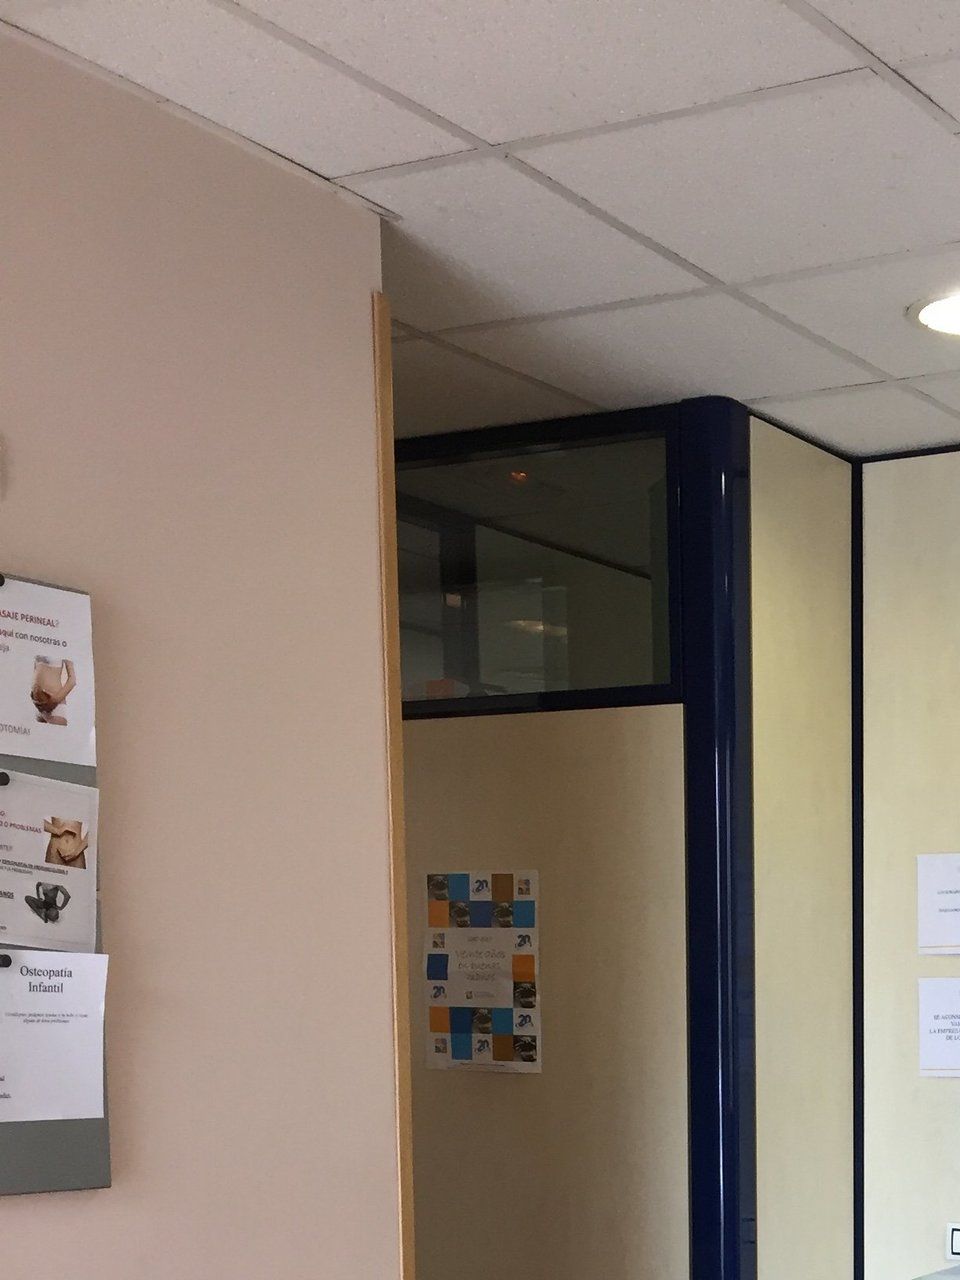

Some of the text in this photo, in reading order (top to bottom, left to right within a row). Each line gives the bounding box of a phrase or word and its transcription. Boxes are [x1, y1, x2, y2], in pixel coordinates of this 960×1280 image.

[30, 634, 61, 646] nosotras
[20, 966, 72, 979] Osteopatía
[28, 982, 64, 994] Infantil
